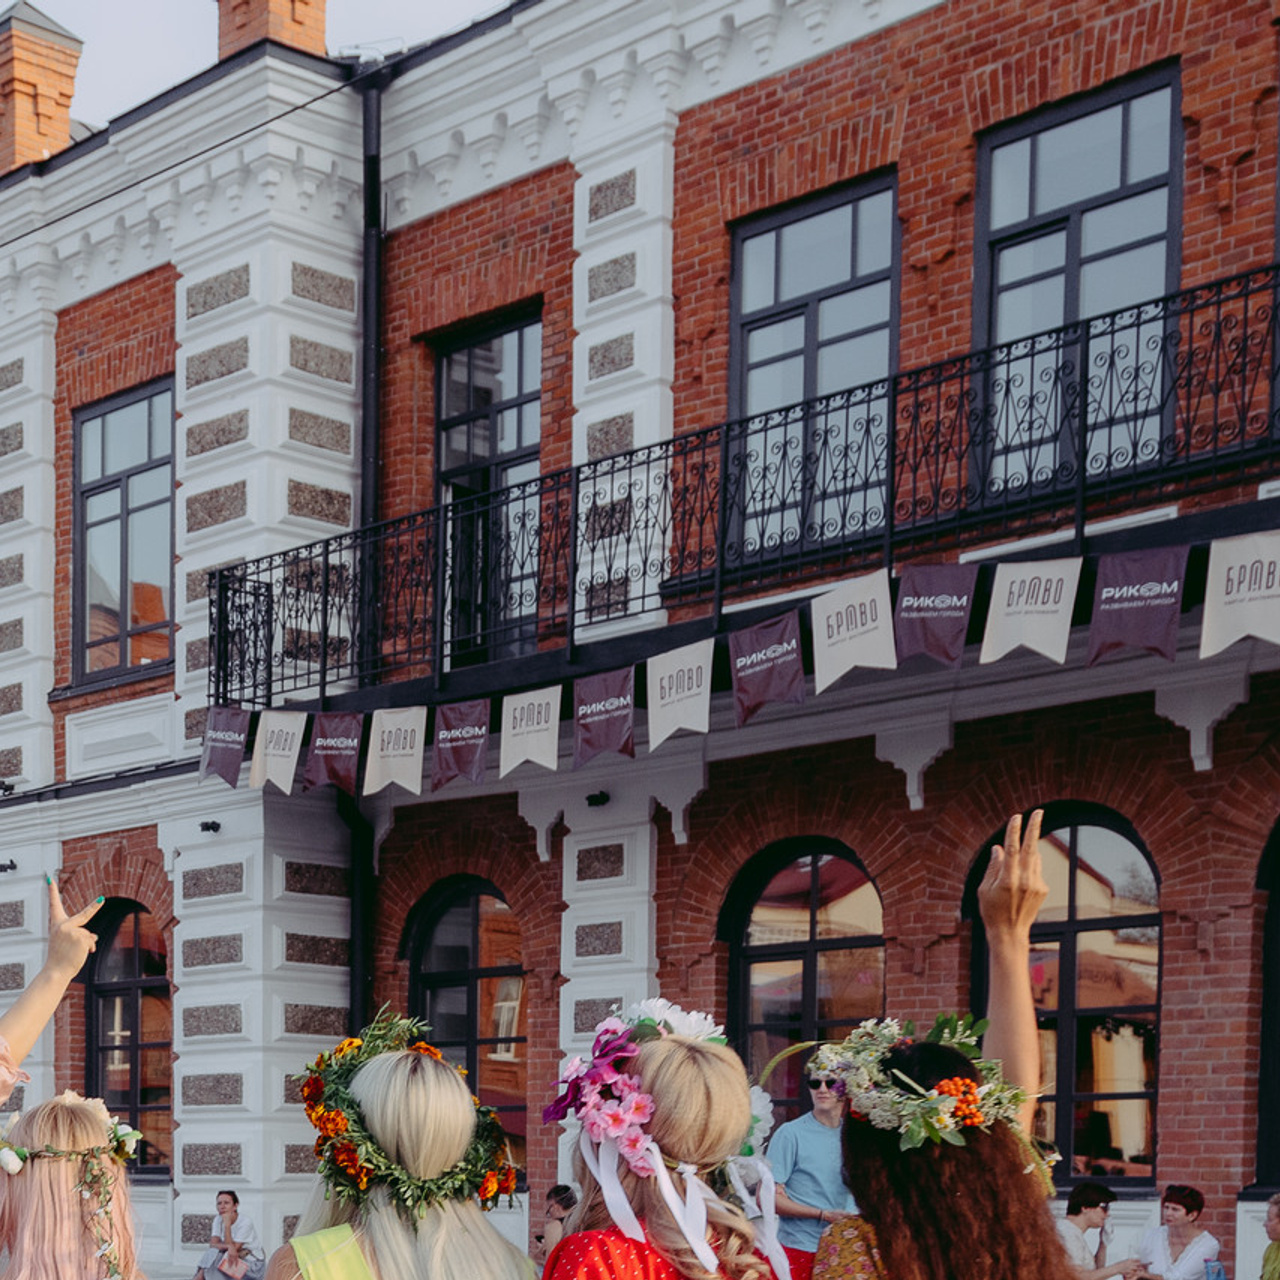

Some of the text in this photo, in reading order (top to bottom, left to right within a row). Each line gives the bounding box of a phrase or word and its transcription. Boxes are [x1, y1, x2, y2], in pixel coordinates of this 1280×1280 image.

[1225, 559, 1280, 596] БРАВ
[1101, 580, 1179, 601] РИКОМ
[902, 594, 968, 609] РИКОМ
[736, 638, 797, 669] РИКОМ
[578, 694, 631, 717] РИКОМ
[206, 730, 245, 742] РИКОМ
[438, 725, 486, 741] РИКОМ
[315, 737, 358, 748] РИКОМ
